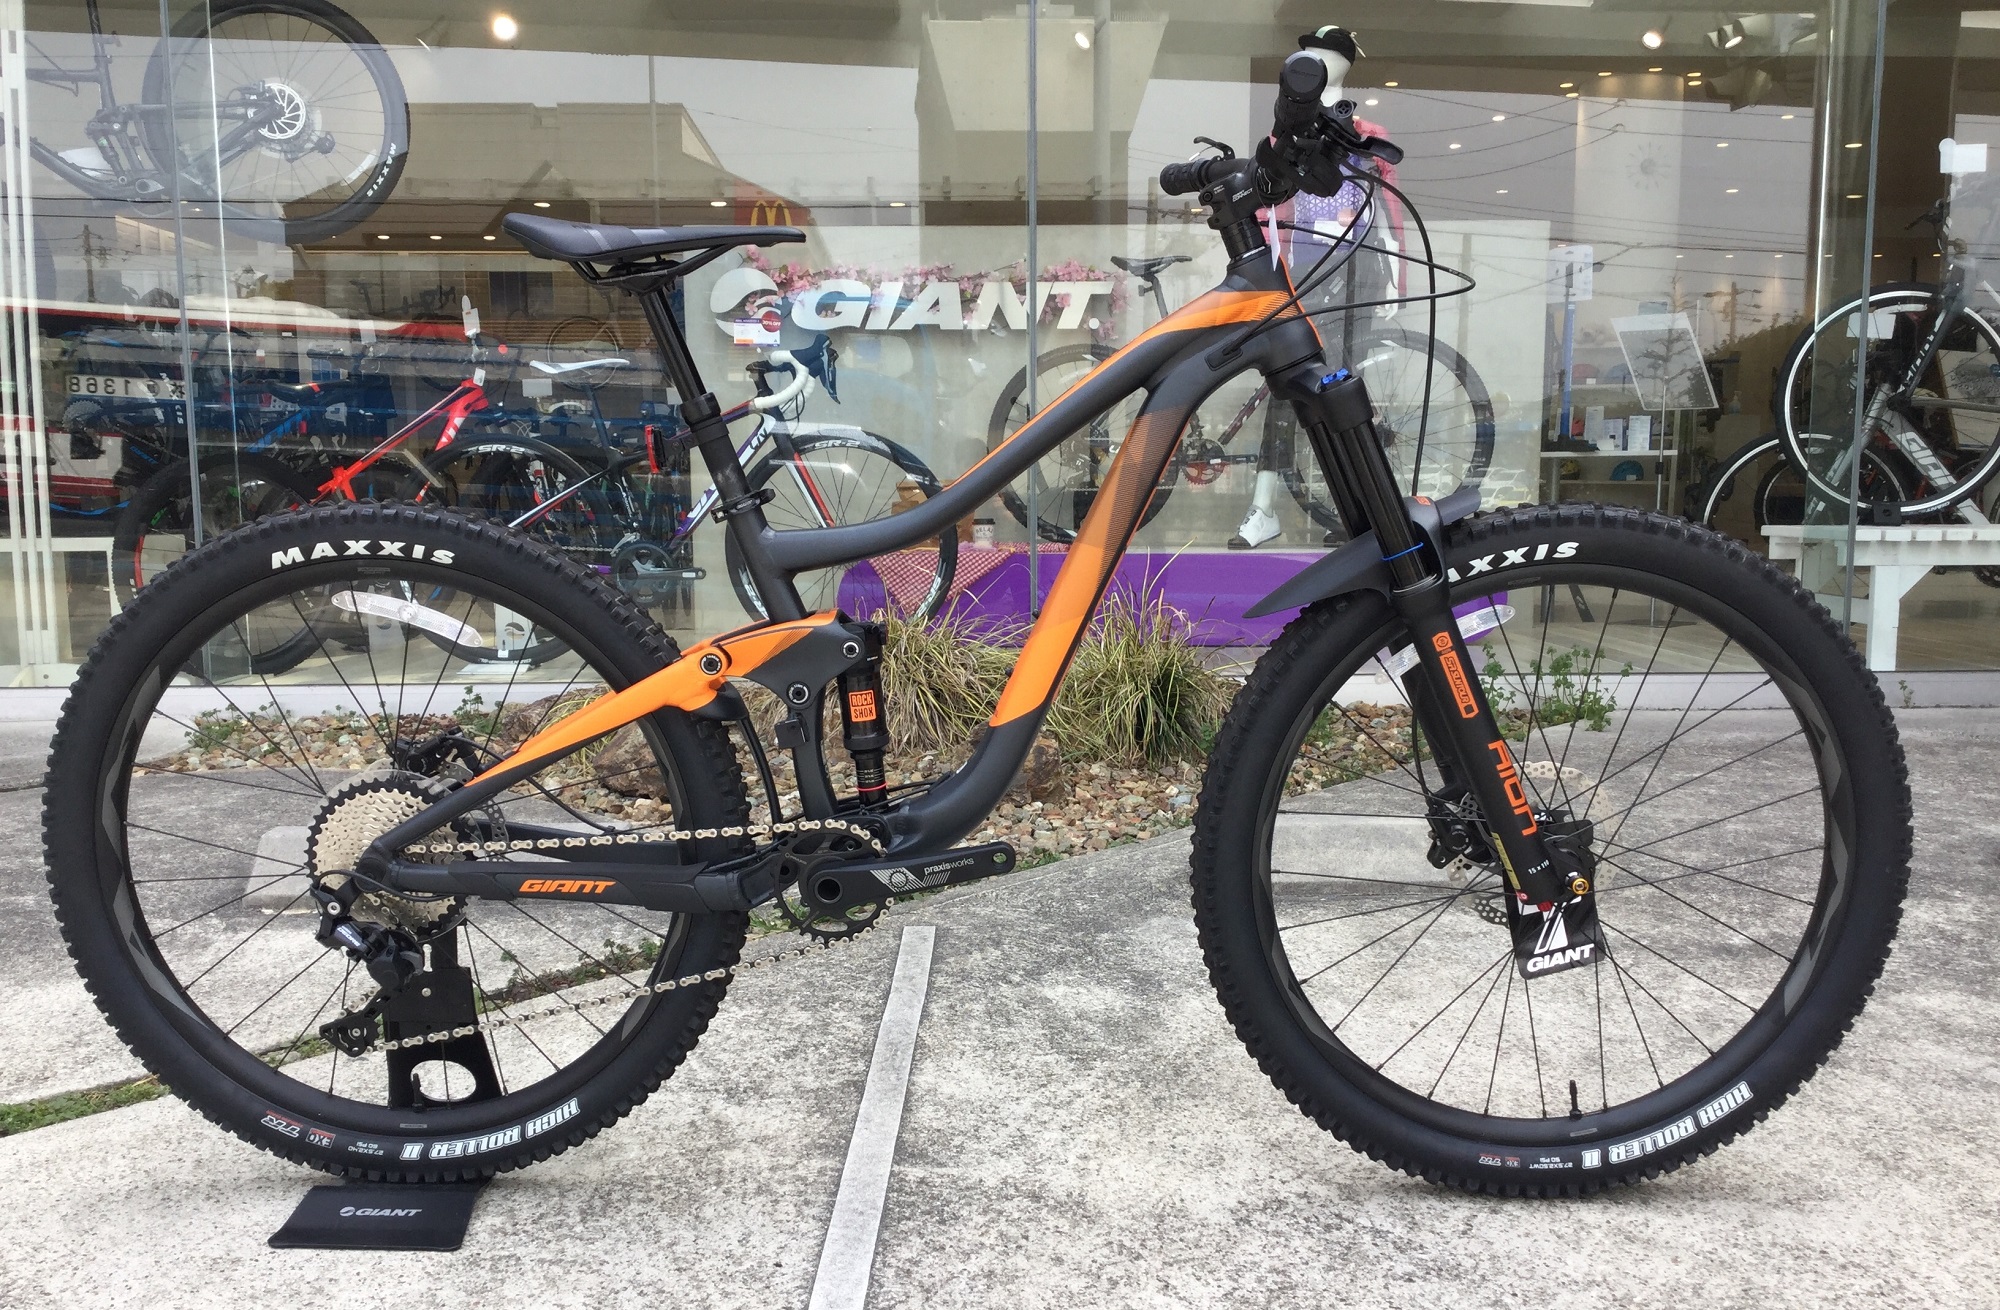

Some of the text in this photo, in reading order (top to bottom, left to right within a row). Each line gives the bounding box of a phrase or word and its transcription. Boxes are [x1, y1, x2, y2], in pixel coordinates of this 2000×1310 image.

[366, 142, 397, 197] MAXXIS
[478, 443, 526, 455] SR-2
[815, 439, 860, 450] SR-2
[271, 539, 456, 570] MAXXIS
[1447, 541, 1580, 583] AXXIS
[851, 693, 873, 706] ROCK
[1450, 669, 1470, 704] SUNTOUR
[854, 707, 874, 719] SHOX
[518, 879, 616, 894] GIANT
[1526, 943, 1595, 973] GIANT
[525, 1098, 581, 1139] HIGH
[1696, 1081, 1754, 1128] HIGH
[260, 1115, 301, 1138] TR
[306, 1132, 333, 1148] EXO
[1609, 1115, 1698, 1164] ROLLER
[428, 1125, 521, 1159] ROLLER
[355, 1208, 423, 1217] GIANT
